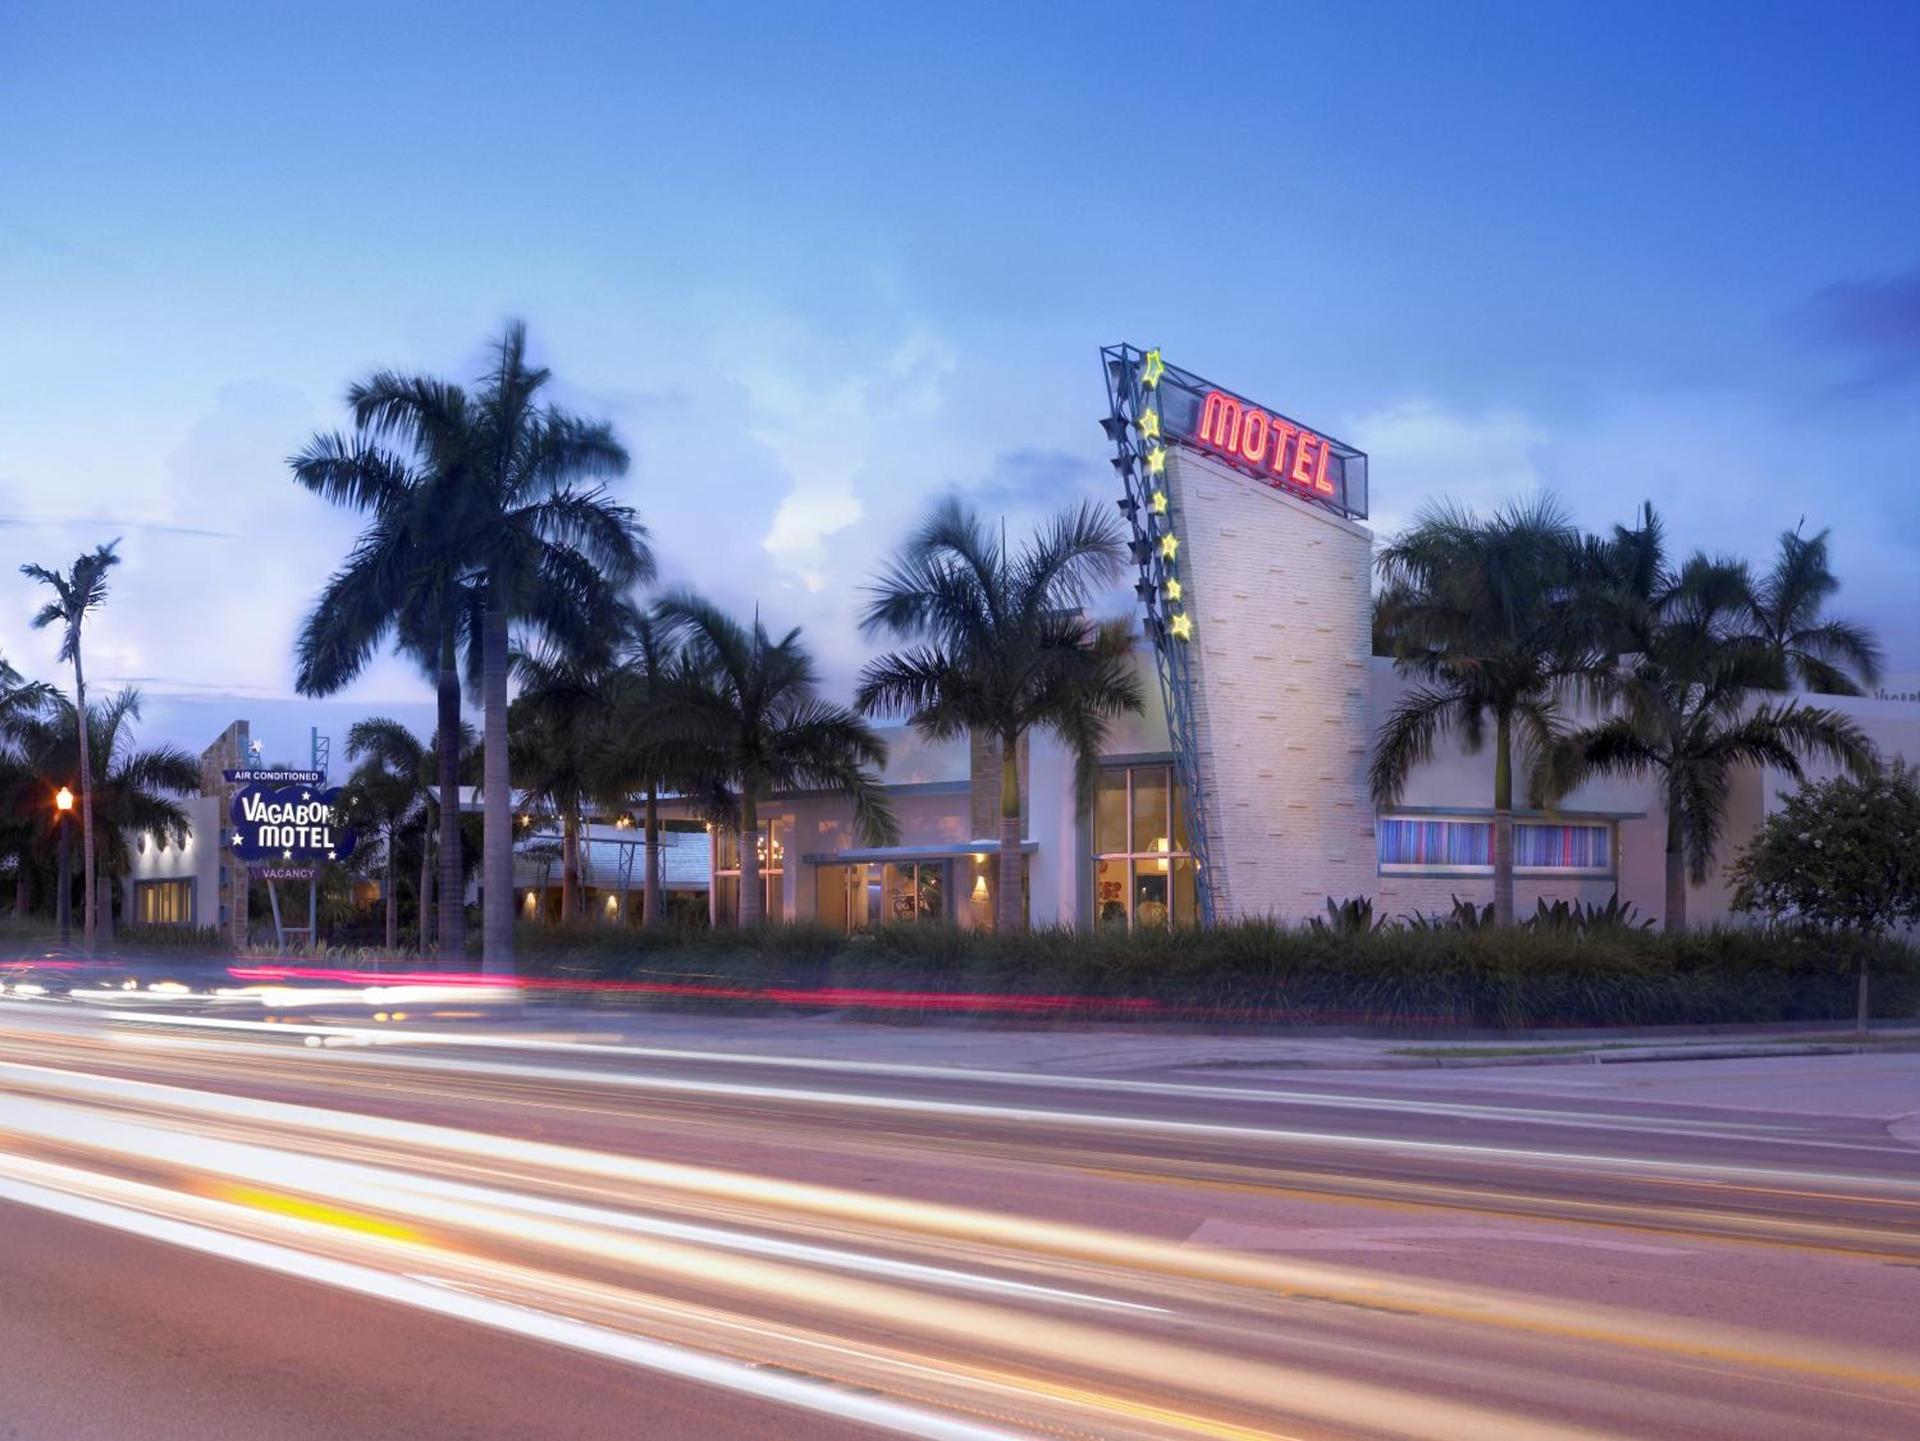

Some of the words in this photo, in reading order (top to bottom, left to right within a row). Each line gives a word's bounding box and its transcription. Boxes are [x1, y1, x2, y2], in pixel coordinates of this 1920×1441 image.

[1196, 389, 1335, 496] MOTEL
[234, 771, 251, 780] AIR
[253, 771, 319, 781] CONDITIONED
[242, 792, 349, 827] VAGABON
[258, 825, 335, 849] MOTEL
[262, 868, 315, 879] VACANCY
